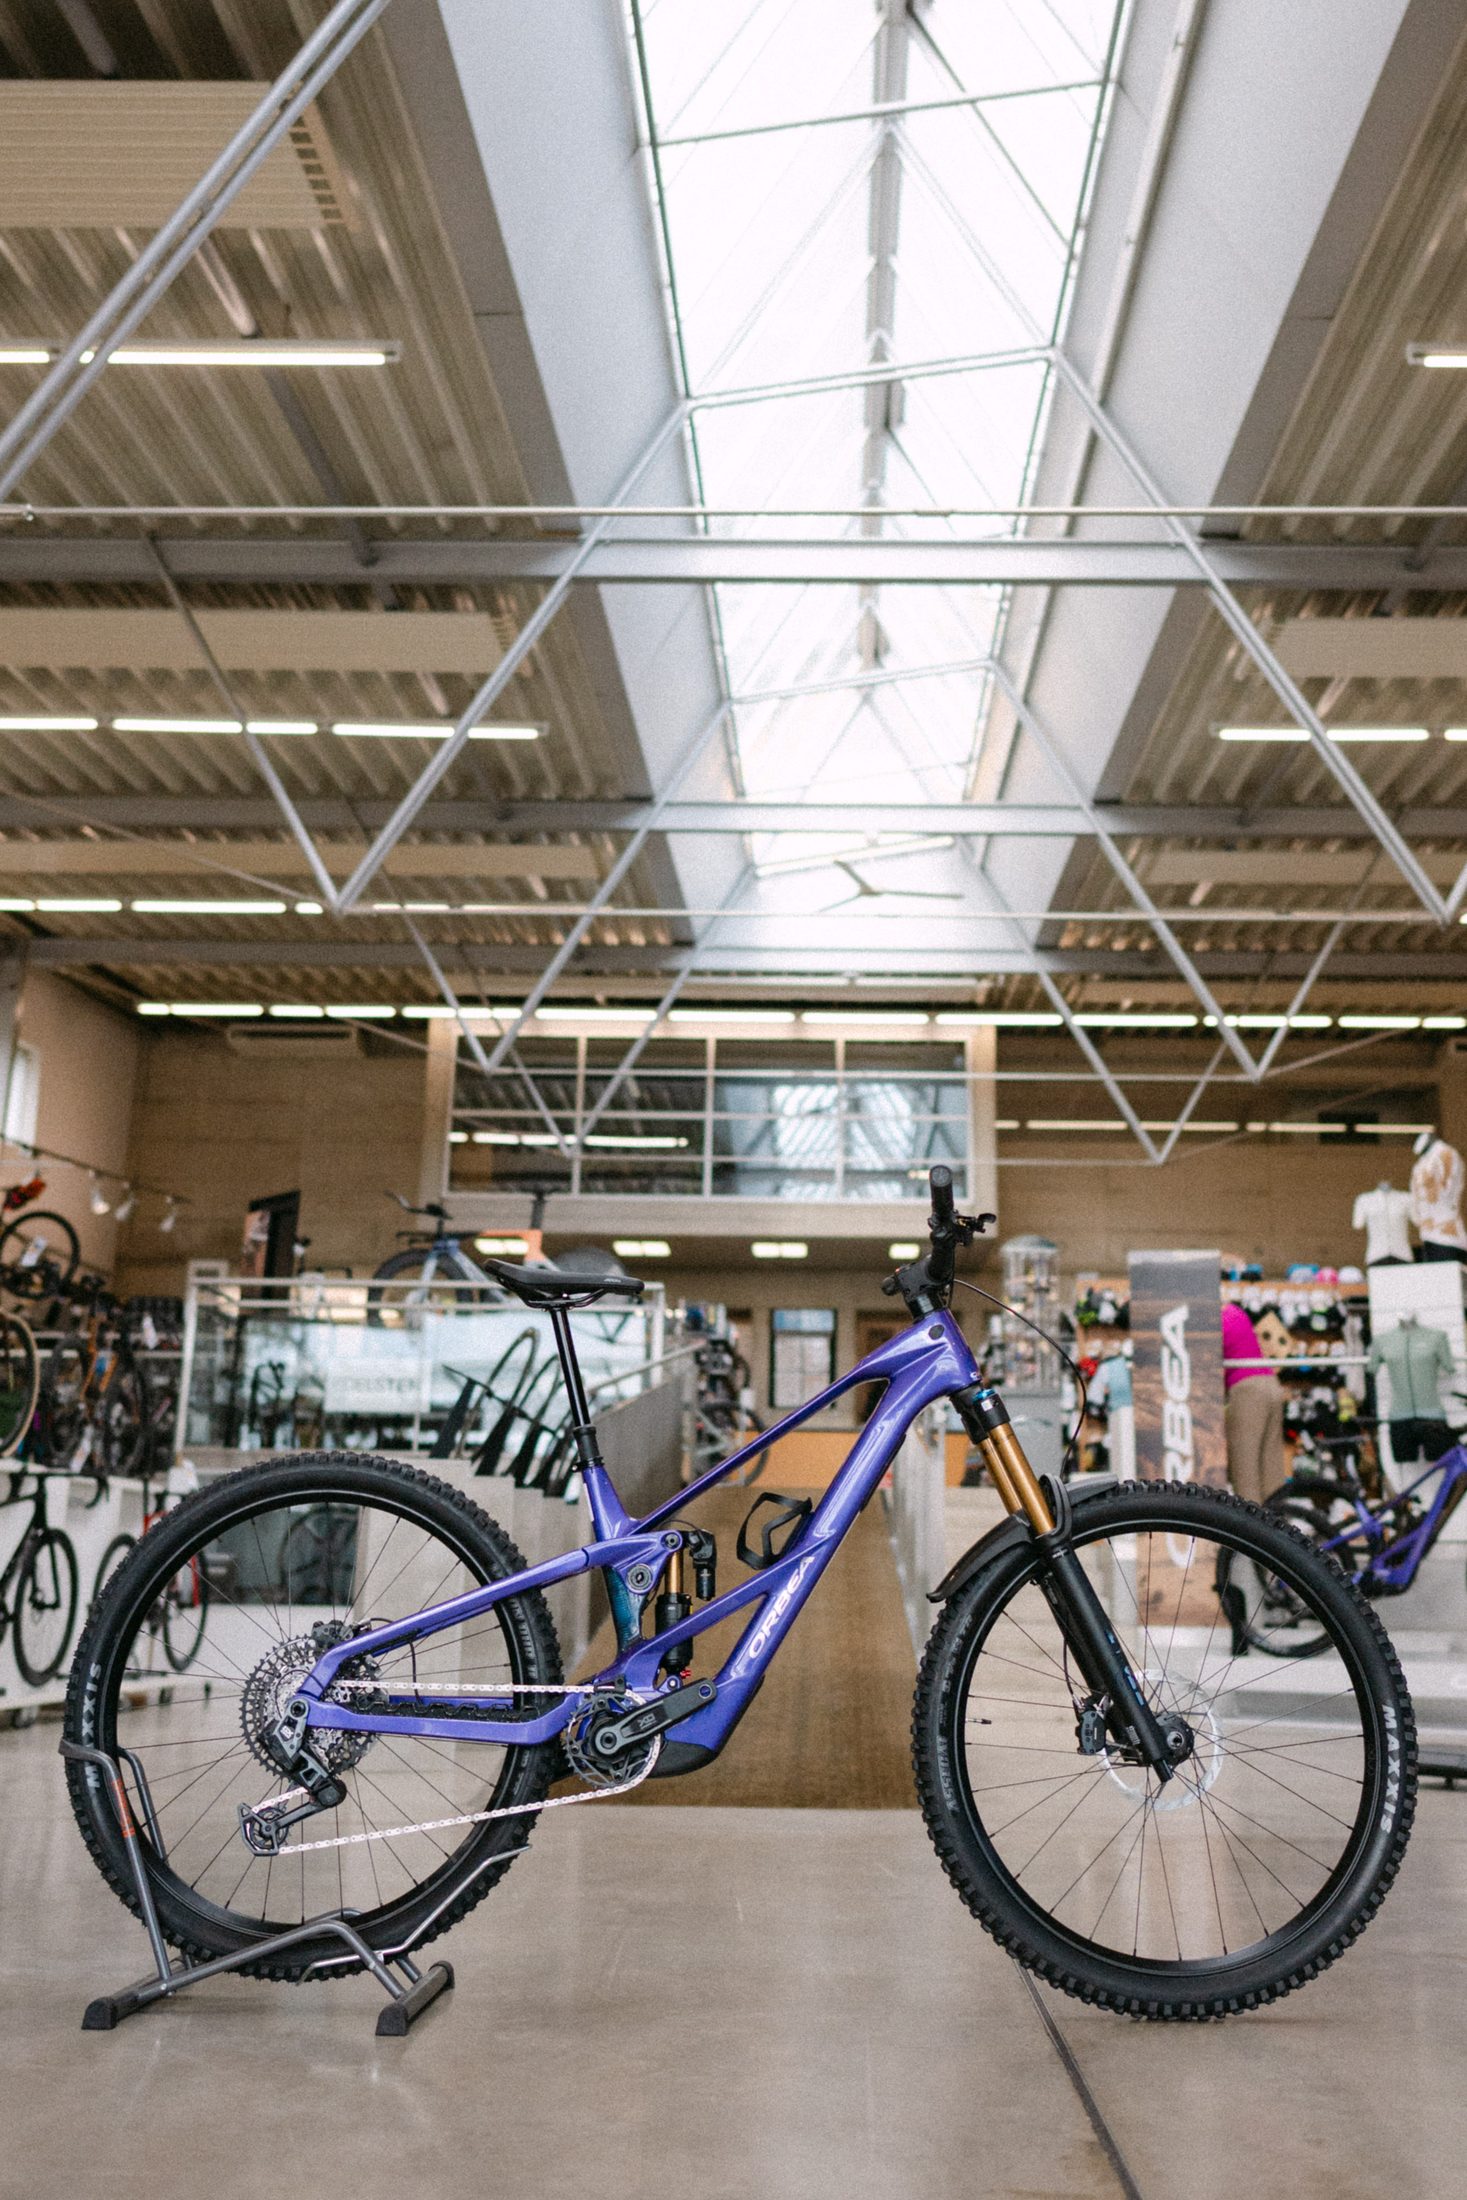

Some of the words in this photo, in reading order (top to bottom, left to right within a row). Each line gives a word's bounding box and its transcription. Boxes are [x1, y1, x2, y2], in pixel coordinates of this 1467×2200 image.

[1160, 1304, 1194, 1569] ORBEA
[749, 1556, 815, 1659] ORBEA
[82, 1662, 101, 1788] MXXIS
[1380, 1704, 1400, 1834] MAXXIS
